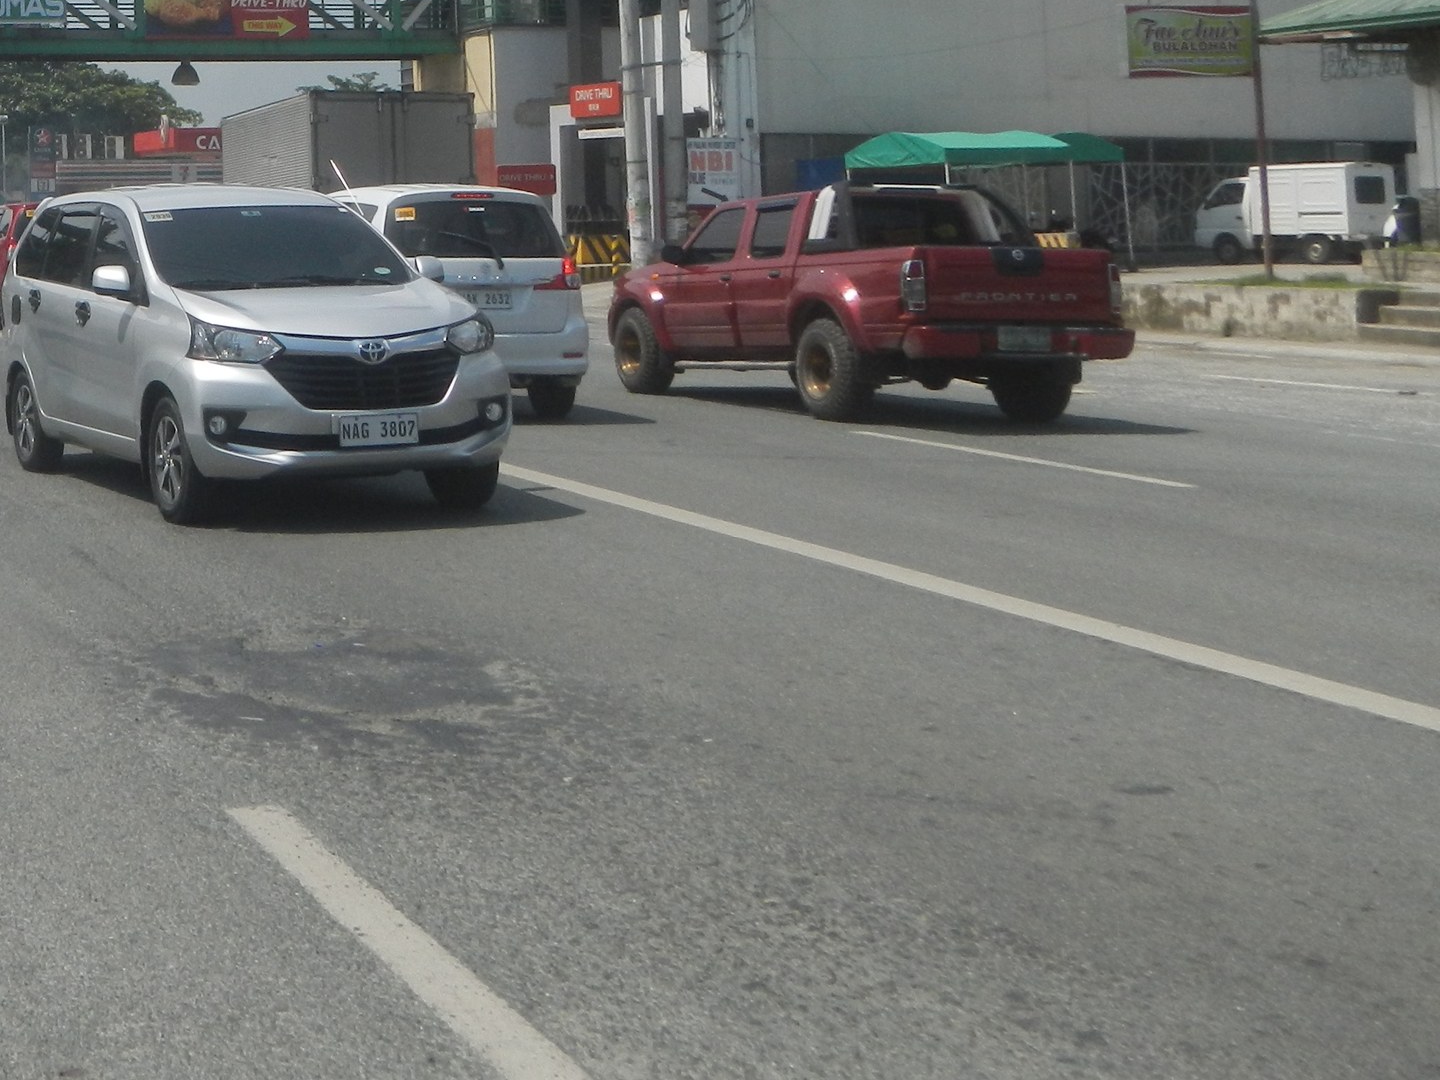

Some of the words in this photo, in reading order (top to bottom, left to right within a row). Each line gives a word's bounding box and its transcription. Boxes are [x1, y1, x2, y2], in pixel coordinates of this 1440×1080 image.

[575, 89, 594, 101] DRIVE
[594, 87, 613, 99] THRU
[196, 135, 221, 150] CA
[690, 151, 733, 171] NBI
[499, 173, 522, 181] DRIVE
[524, 173, 546, 181] THRU
[485, 293, 510, 305] 2632
[342, 422, 369, 439] NAG
[380, 420, 415, 437] 3807
